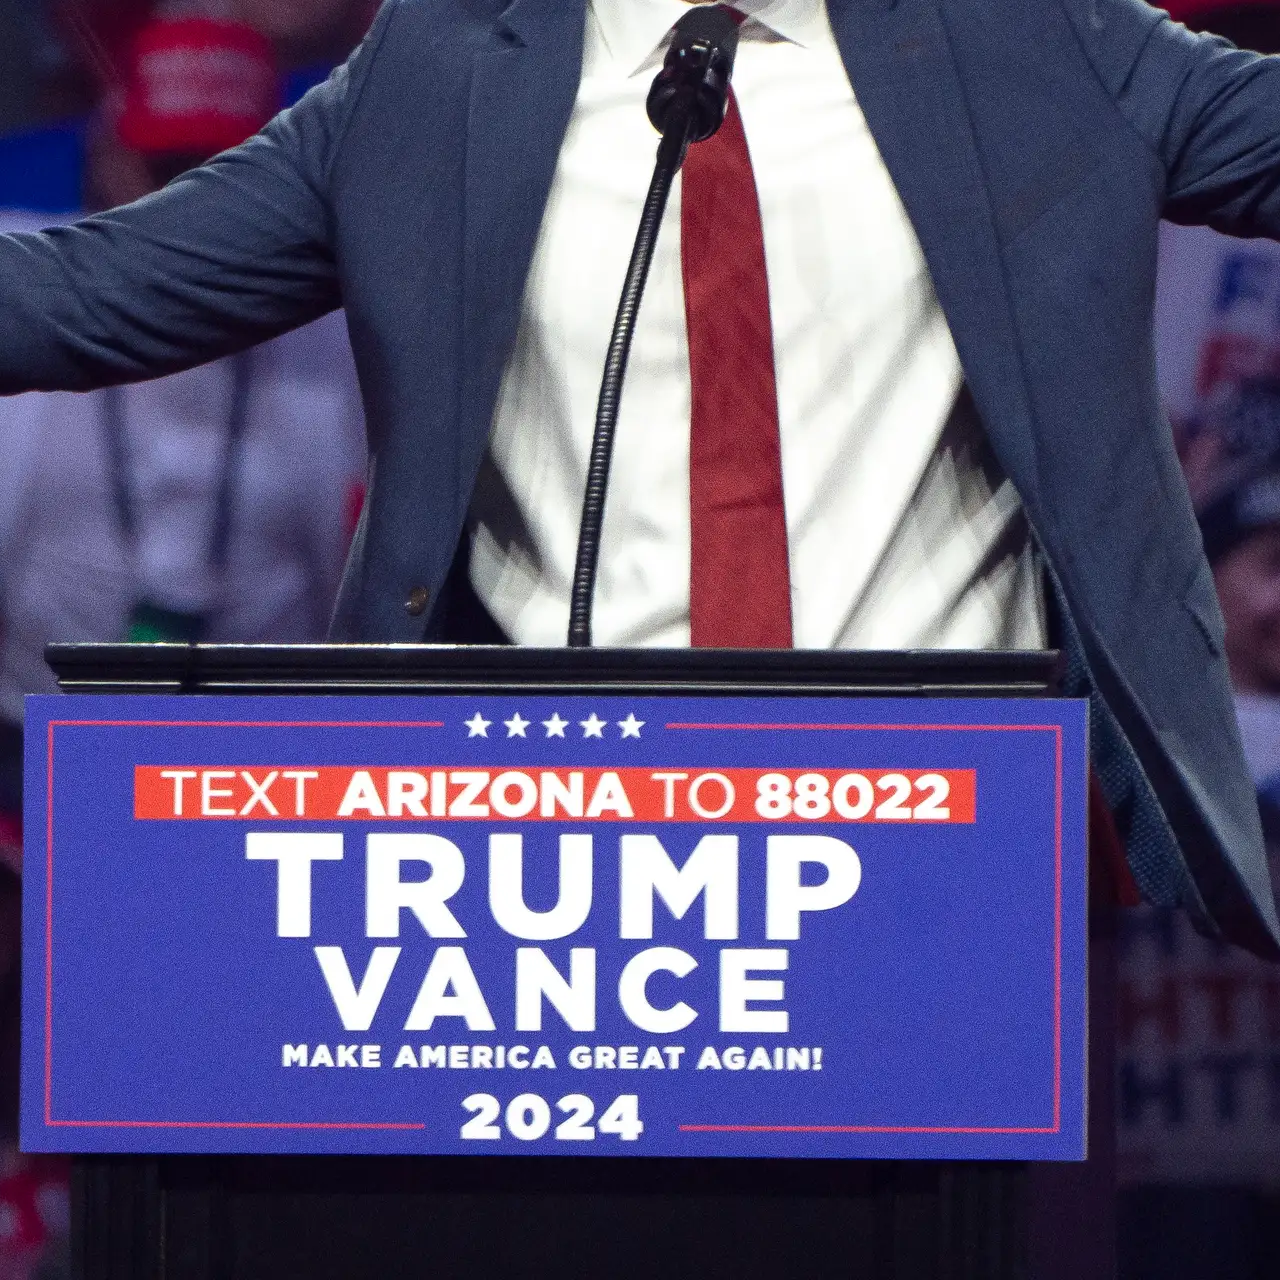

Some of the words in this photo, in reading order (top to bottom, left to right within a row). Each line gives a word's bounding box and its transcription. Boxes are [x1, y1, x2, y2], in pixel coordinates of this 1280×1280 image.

[161, 770, 319, 816] TEXT
[337, 770, 635, 819] ARIZONA
[650, 772, 735, 819] TO
[754, 772, 950, 820] 88022
[245, 832, 862, 941] TRUMP
[314, 945, 790, 1034] VANCE
[281, 1043, 382, 1068] MAKE
[393, 1044, 557, 1070] AMERICA
[568, 1045, 686, 1070] GREAT
[697, 1046, 823, 1071] AGAIN!
[460, 1092, 644, 1141] 2024
